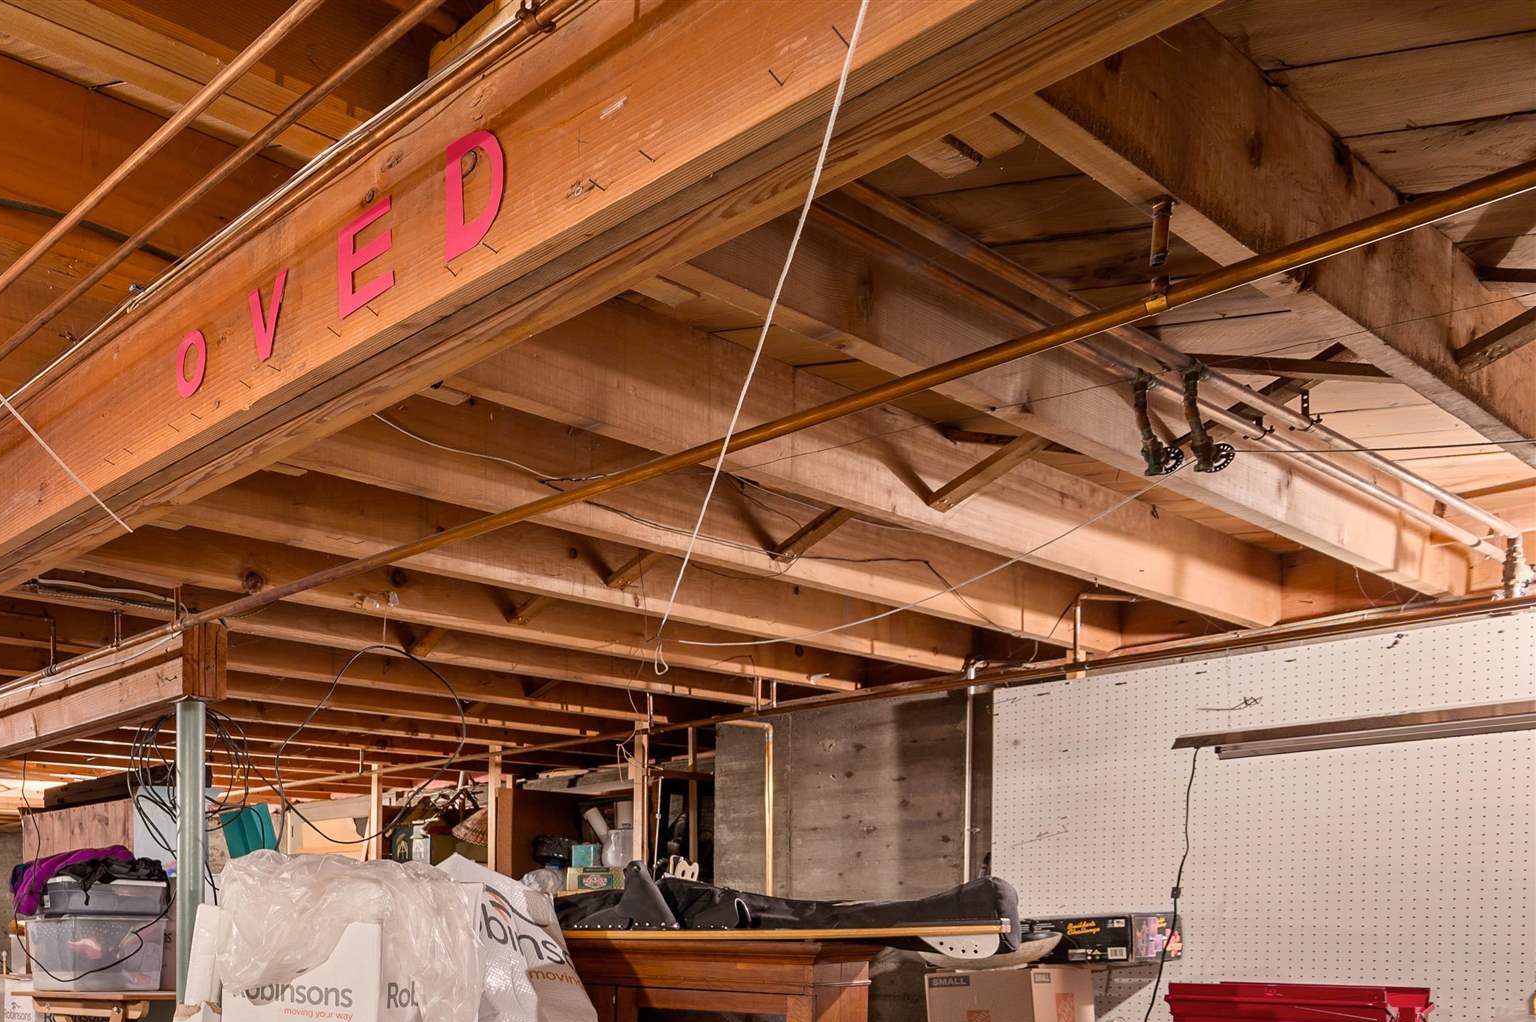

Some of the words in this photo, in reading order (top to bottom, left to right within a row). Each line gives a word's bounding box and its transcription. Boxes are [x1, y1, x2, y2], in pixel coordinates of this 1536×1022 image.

[528, 970, 582, 986] movin
[932, 977, 967, 986] SMALL
[233, 983, 353, 1008] obinsons
[284, 1008, 314, 1018] moving
[315, 1010, 333, 1019] your
[335, 1012, 353, 1022] way
